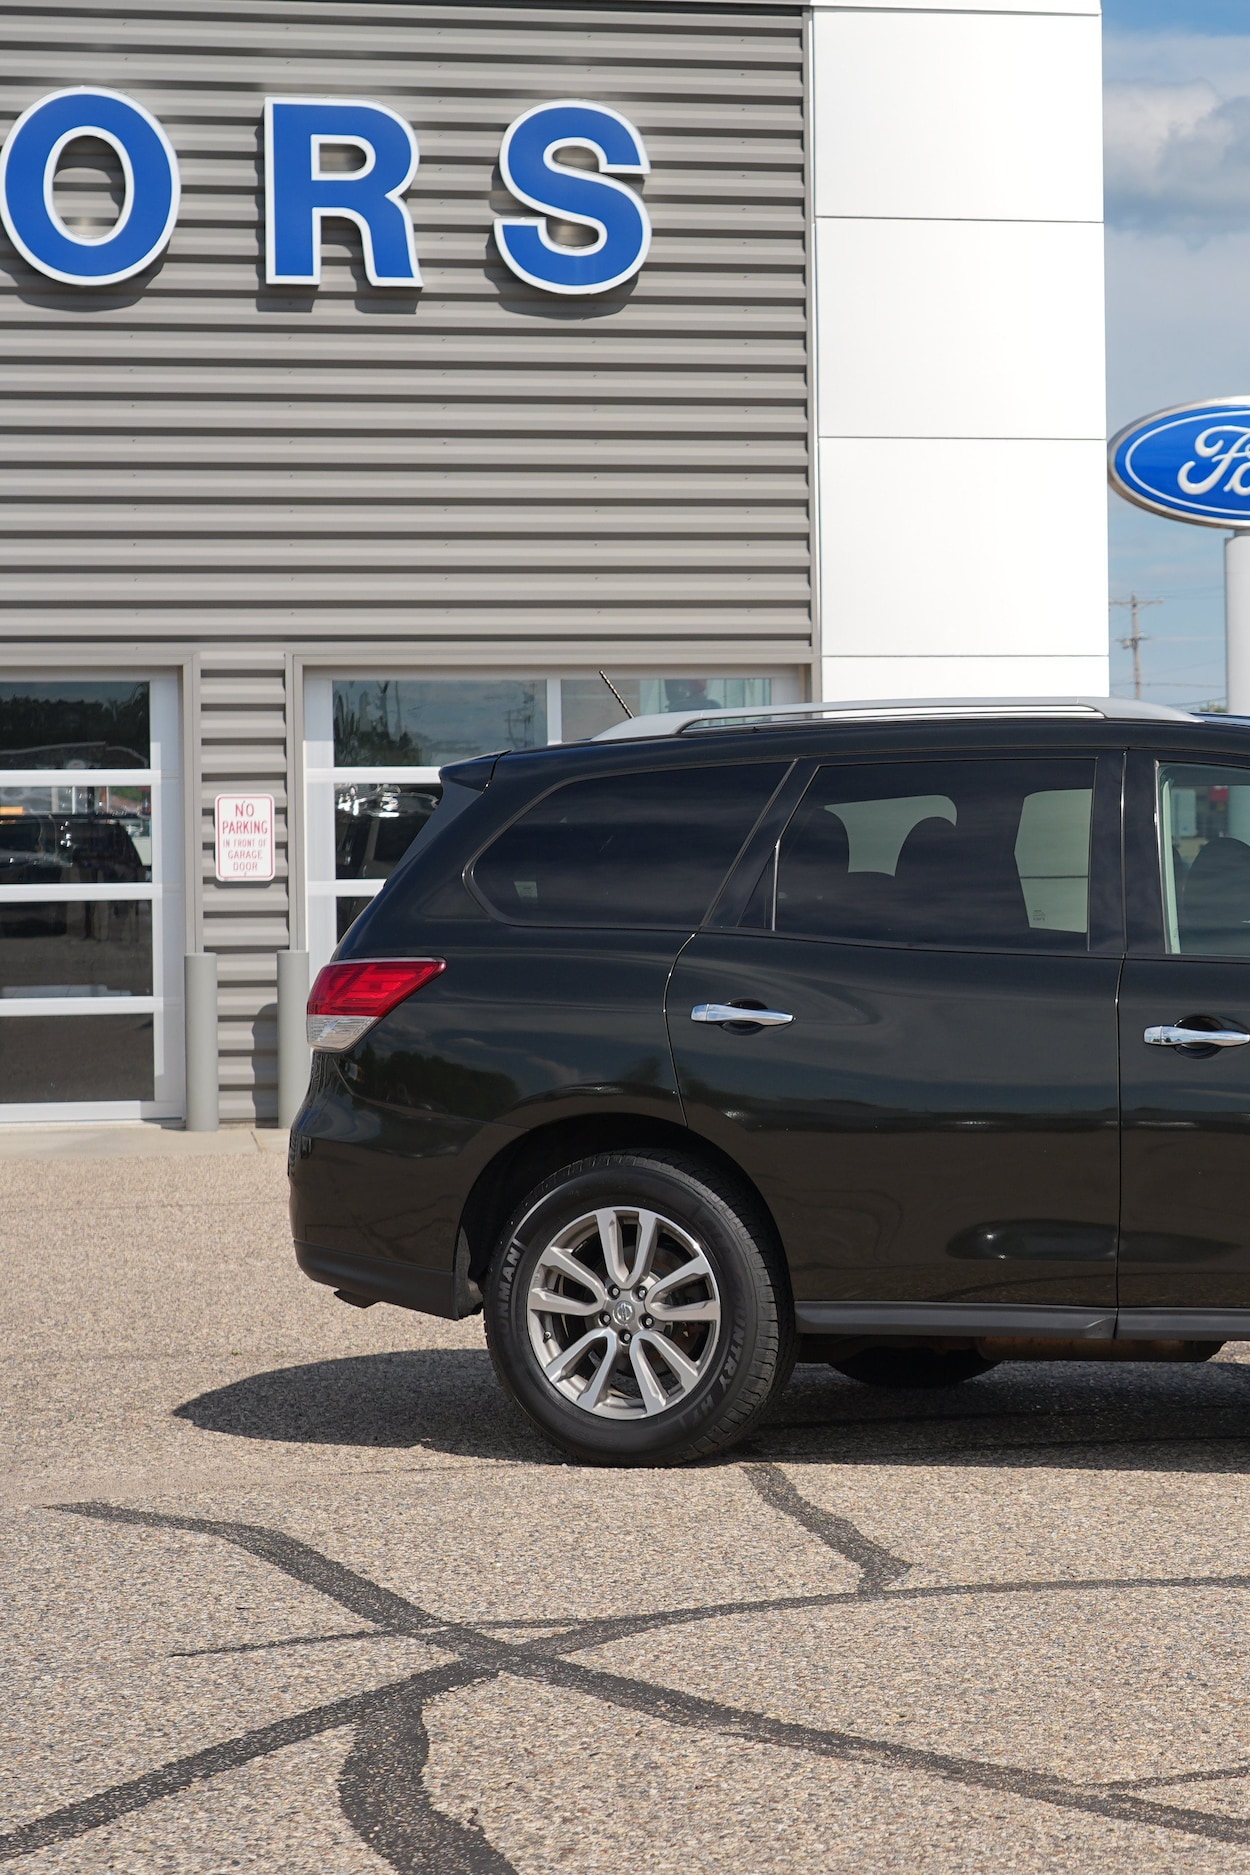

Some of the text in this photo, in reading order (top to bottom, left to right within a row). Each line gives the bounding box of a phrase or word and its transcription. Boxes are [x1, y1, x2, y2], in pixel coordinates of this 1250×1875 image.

[0, 86, 652, 294] ORS
[235, 803, 255, 817] NO
[222, 821, 268, 835] PARKING
[223, 839, 267, 847] IN FRONT OF
[227, 850, 263, 859] GARAGE
[233, 862, 258, 871] DOOR
[496, 1247, 522, 1334] ONMAN
